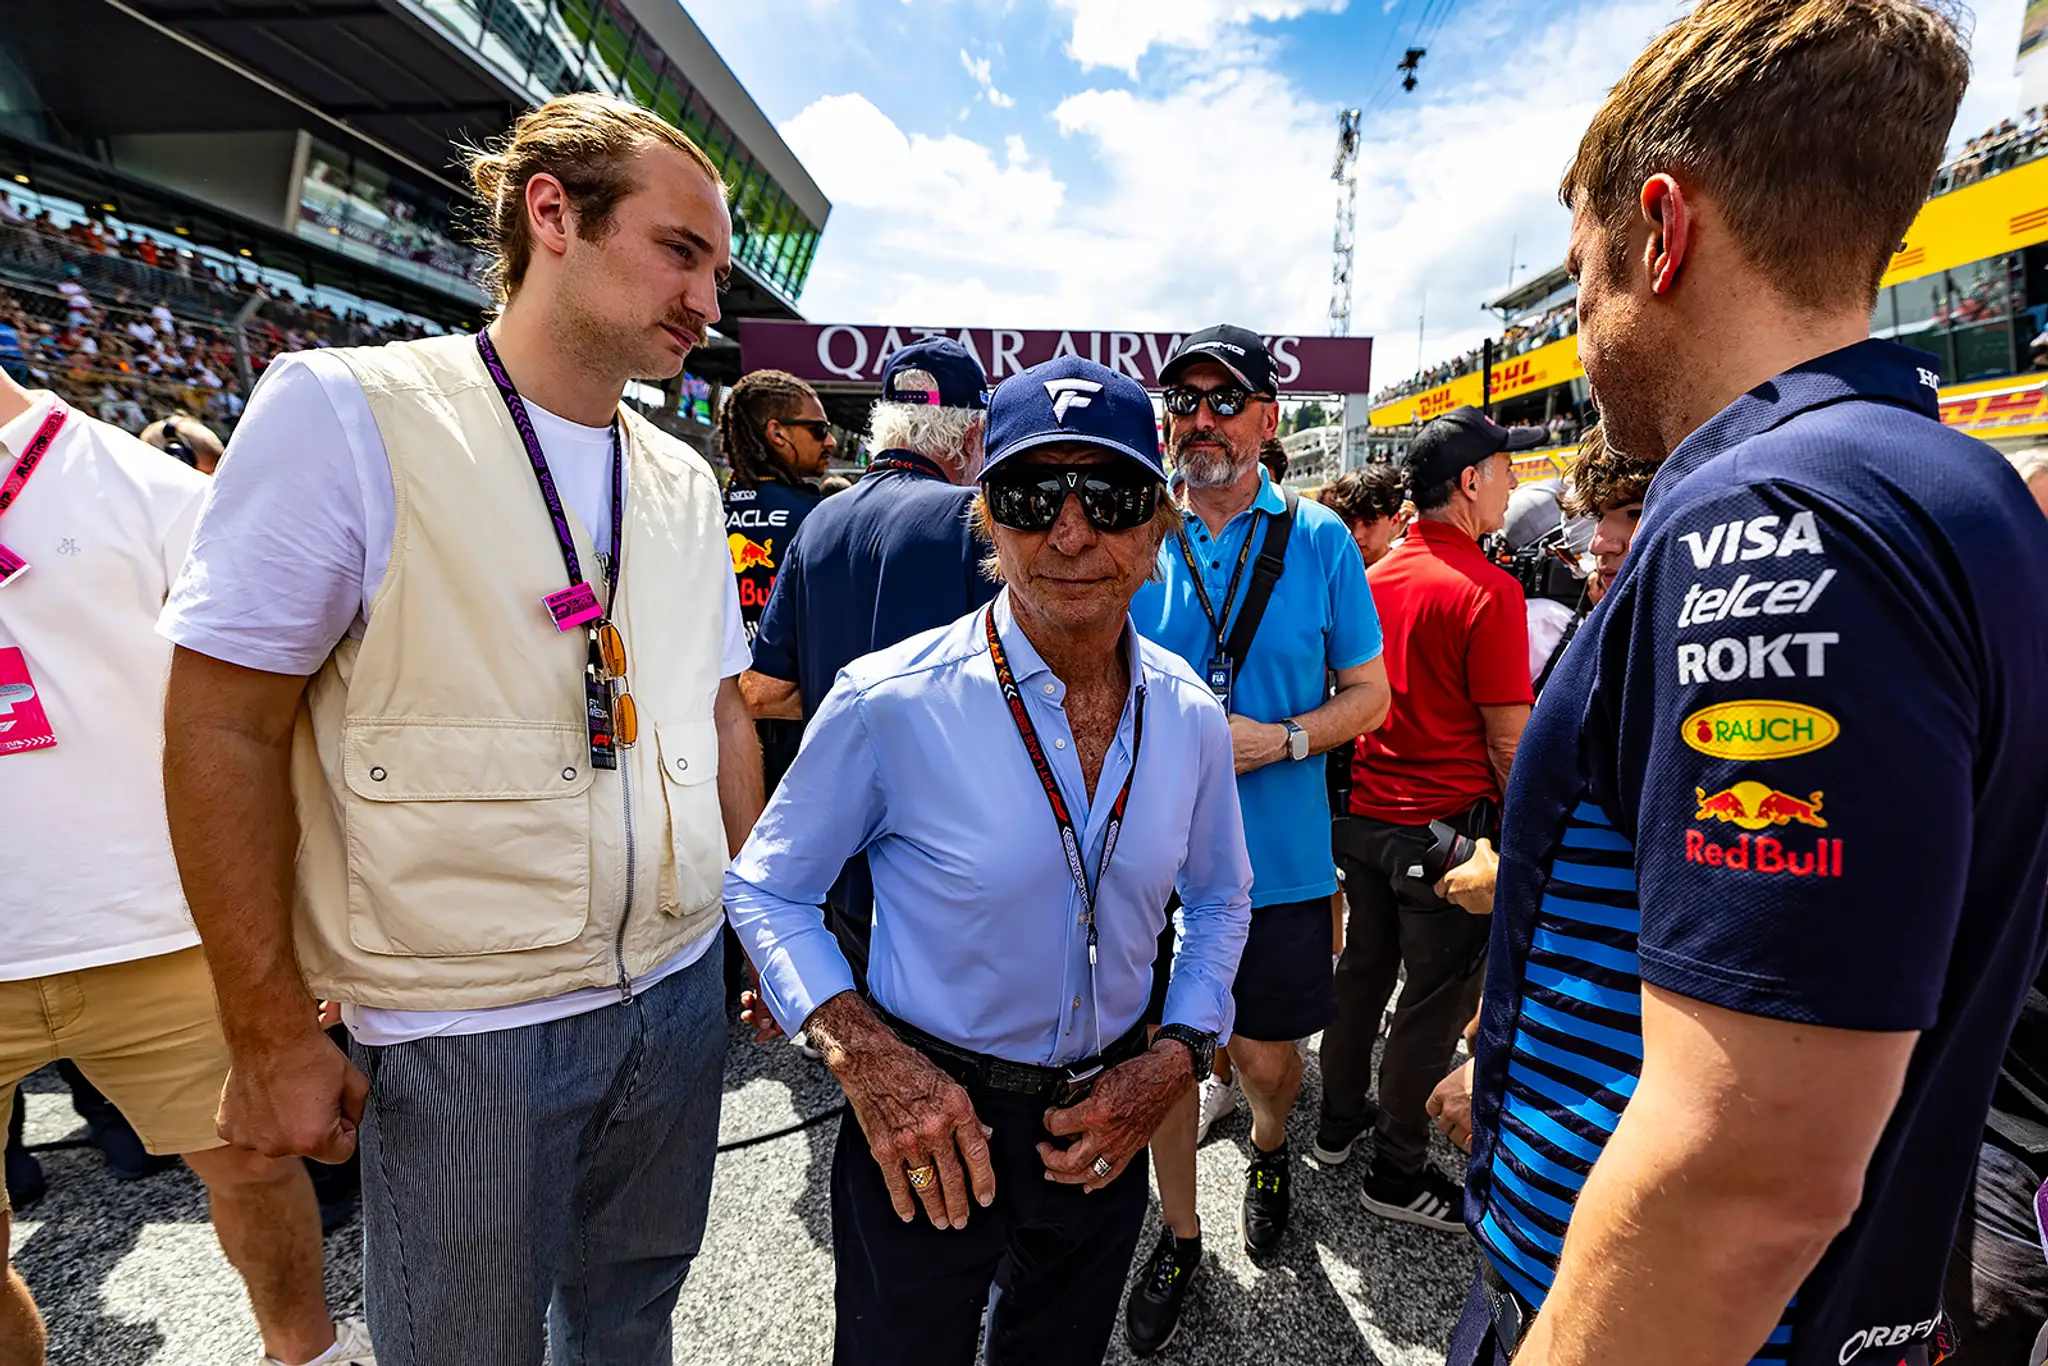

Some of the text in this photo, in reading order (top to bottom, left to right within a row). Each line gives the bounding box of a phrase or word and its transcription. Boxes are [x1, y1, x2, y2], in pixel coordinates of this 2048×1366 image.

[724, 509, 790, 528] ACLE
[1677, 510, 1826, 569] VISA
[1677, 568, 1837, 629] telcel
[1677, 632, 1840, 686] ROKT
[1024, 733, 1050, 772] LANE
[1715, 717, 1814, 743] RAUCH
[1685, 829, 1844, 878] Red Bull
